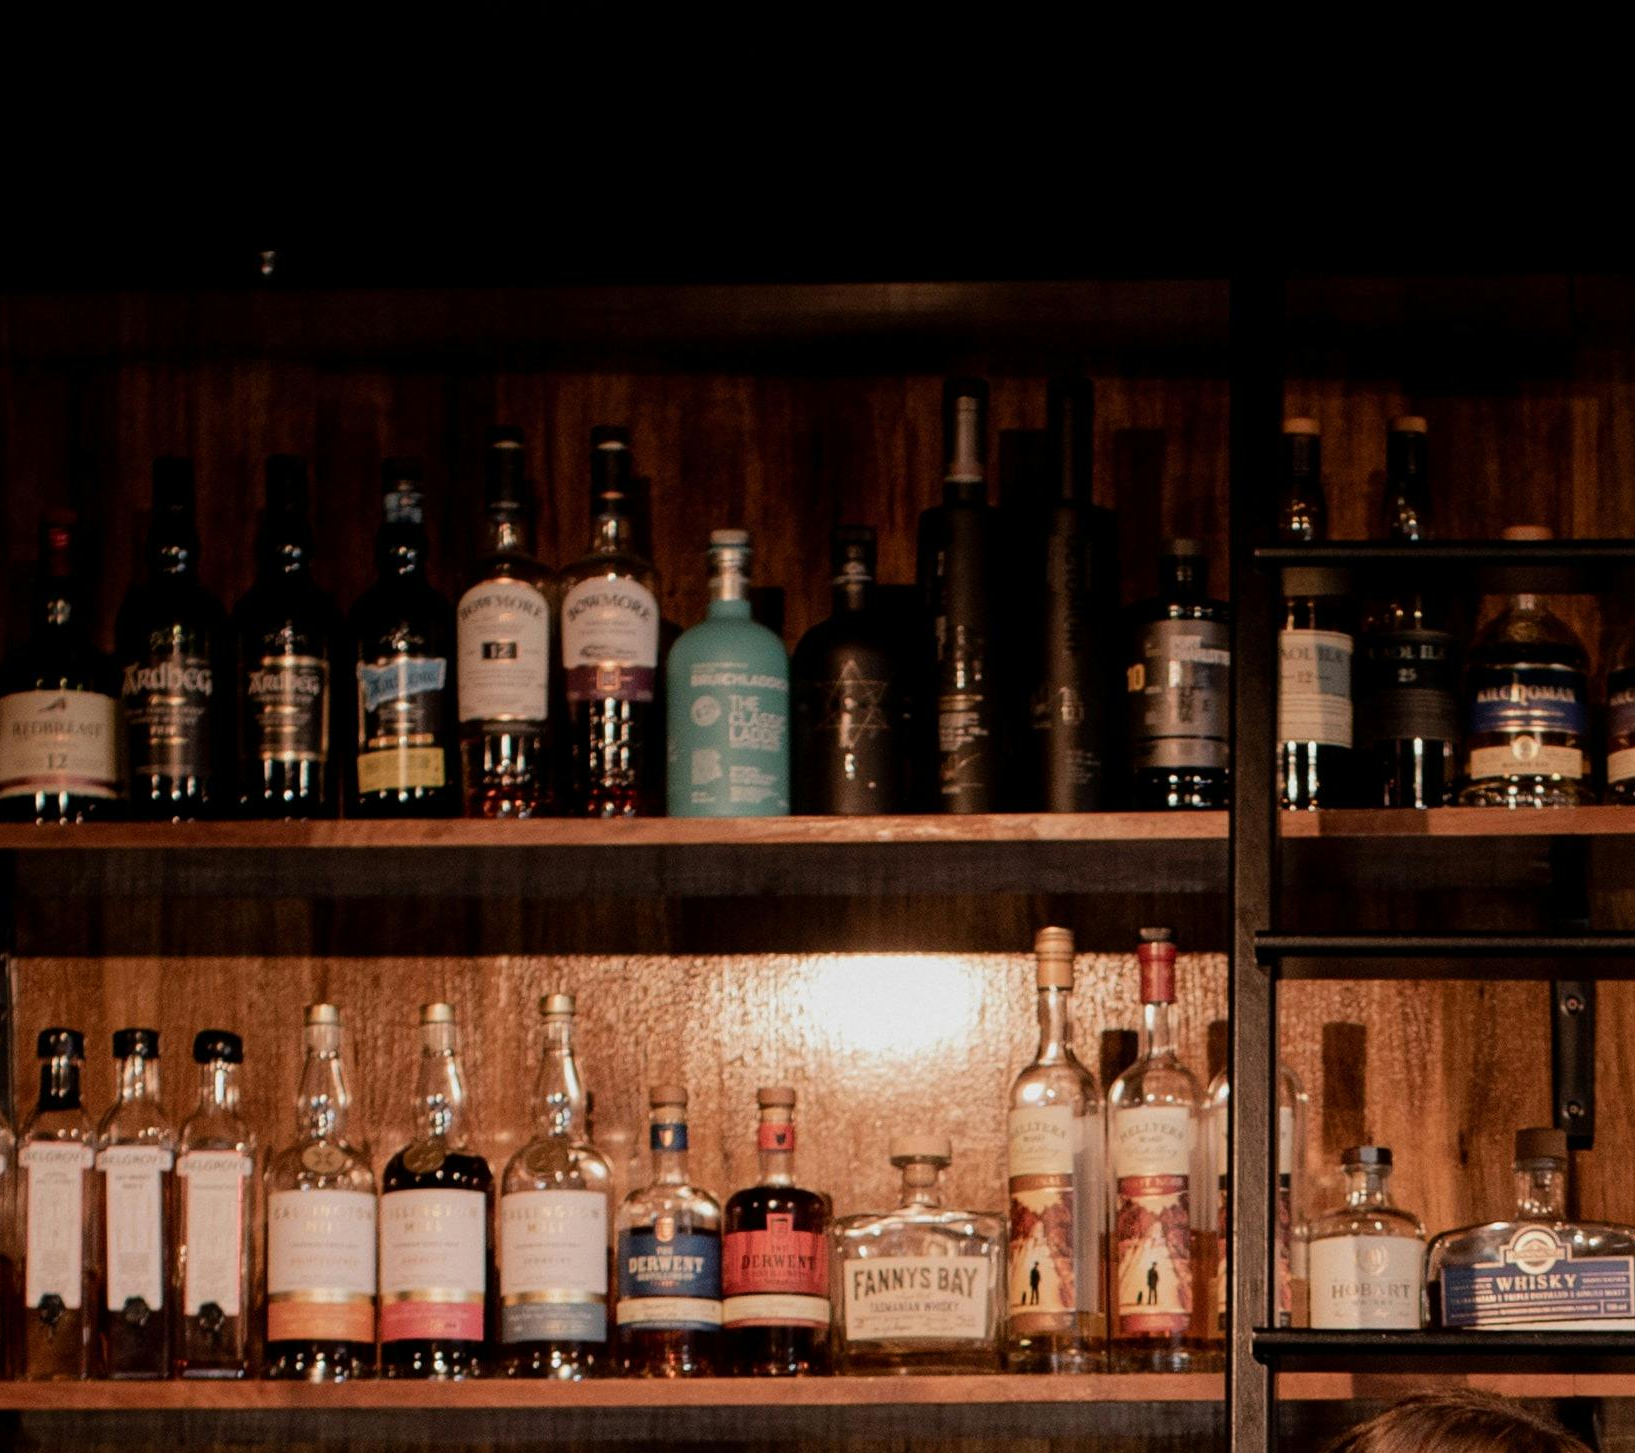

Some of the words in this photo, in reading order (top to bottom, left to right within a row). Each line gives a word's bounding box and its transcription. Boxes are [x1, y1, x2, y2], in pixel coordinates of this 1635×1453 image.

[853, 1268, 931, 1300] FANNYS
[938, 1268, 978, 1300] BAY
[1495, 1275, 1577, 1291] WHISKY
